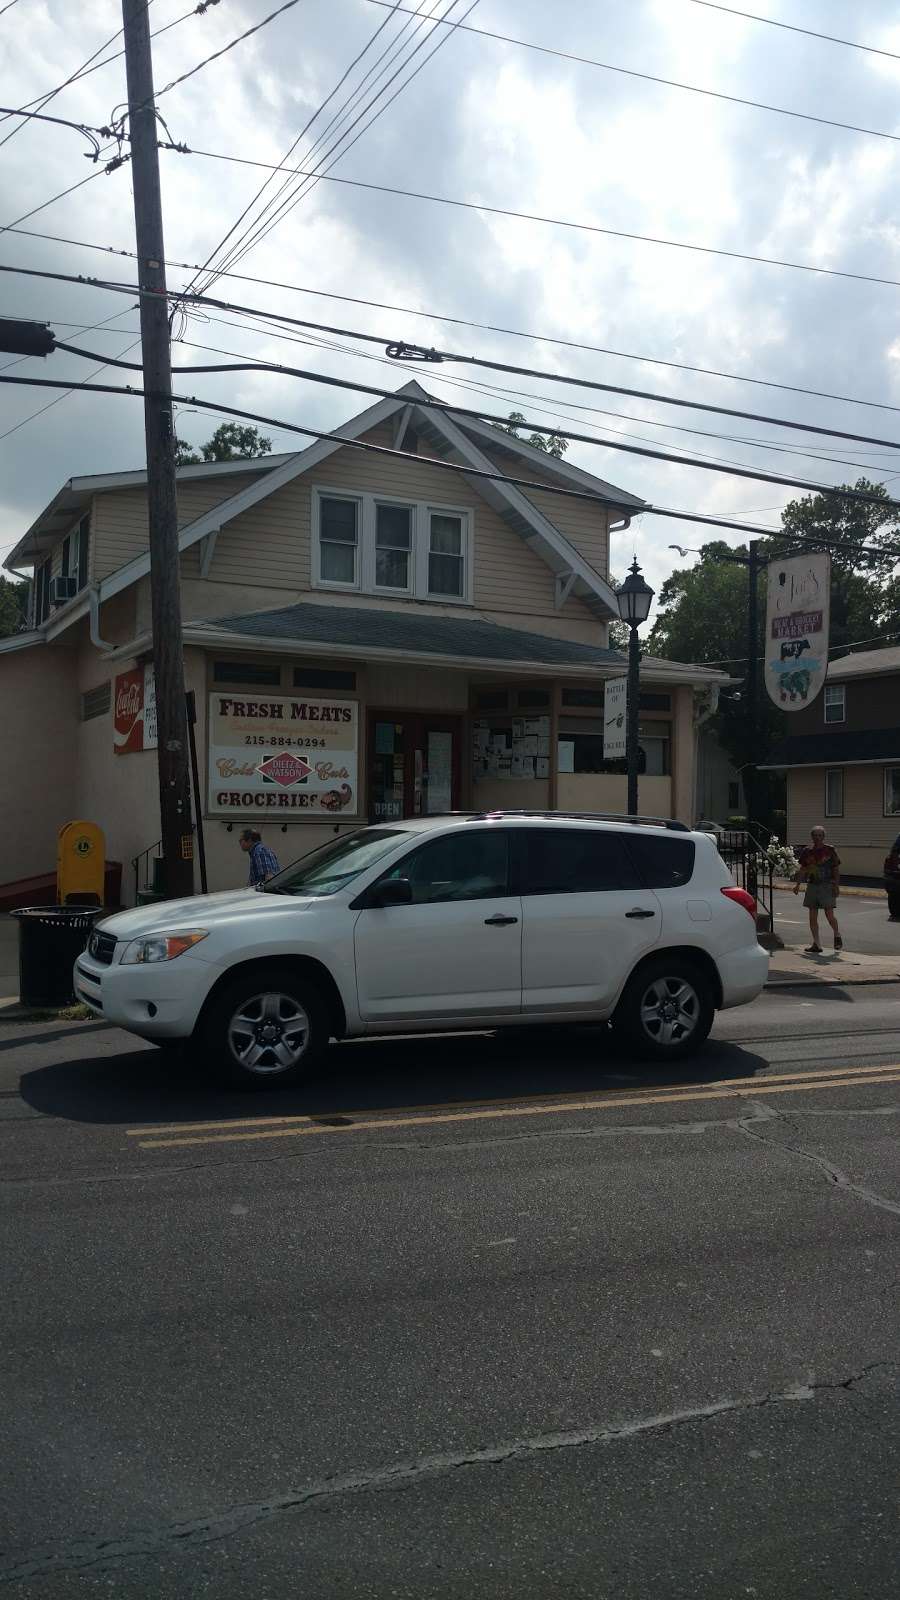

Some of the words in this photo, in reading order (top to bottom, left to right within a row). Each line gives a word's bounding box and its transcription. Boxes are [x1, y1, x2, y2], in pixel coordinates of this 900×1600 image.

[777, 622, 816, 638] MARKET
[606, 684, 625, 695] BATTLE
[219, 699, 284, 719] FRESH
[290, 703, 352, 723] MEATS
[244, 735, 327, 748] 215-884-0294
[215, 757, 257, 779] Cold
[314, 761, 350, 781] Cuts
[272, 759, 295, 769] DIETZ
[267, 767, 302, 778] WATSON
[216, 792, 319, 809] GROCERIES
[375, 802, 400, 816] OPEN
